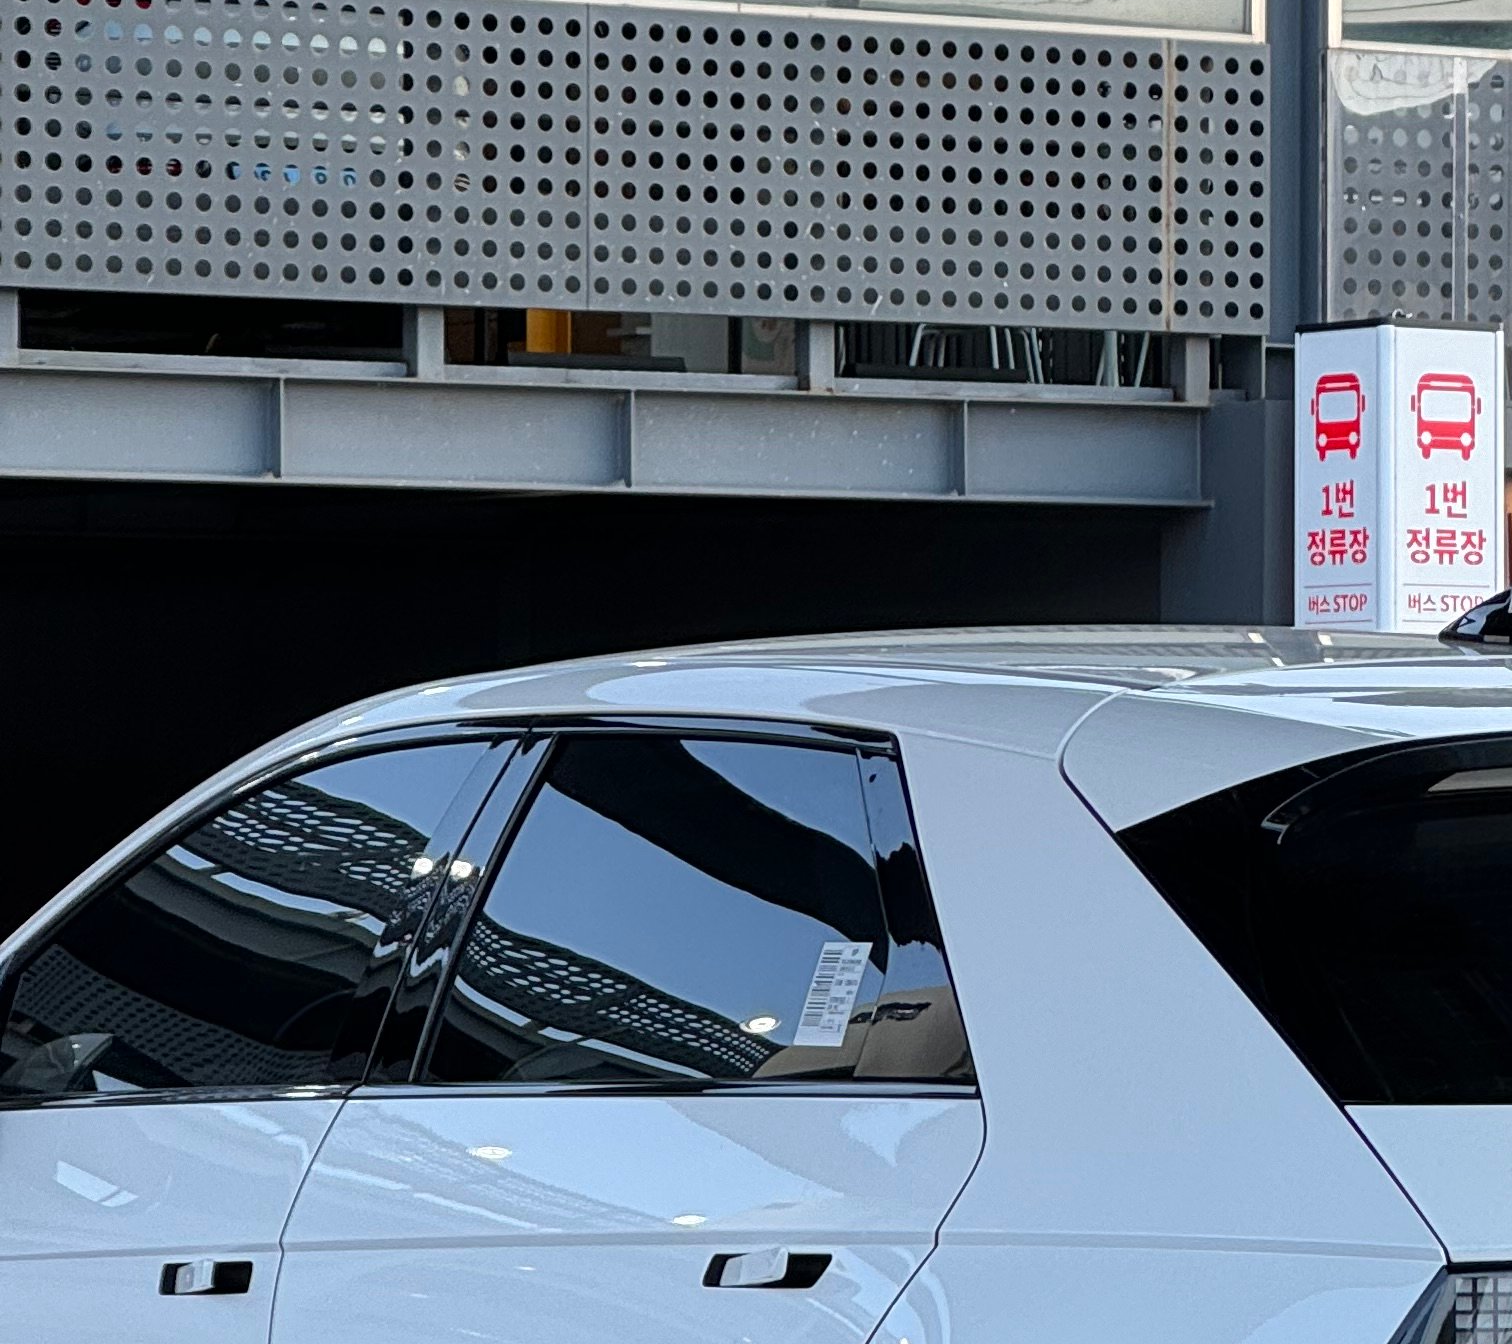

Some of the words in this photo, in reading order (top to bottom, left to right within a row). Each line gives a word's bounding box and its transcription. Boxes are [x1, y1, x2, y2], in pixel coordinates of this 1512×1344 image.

[1321, 479, 1355, 519] 1번
[1424, 480, 1468, 519] 1번
[1307, 527, 1369, 566] 정류장
[1406, 528, 1487, 566] 정류장
[1408, 592, 1435, 614] 버스
